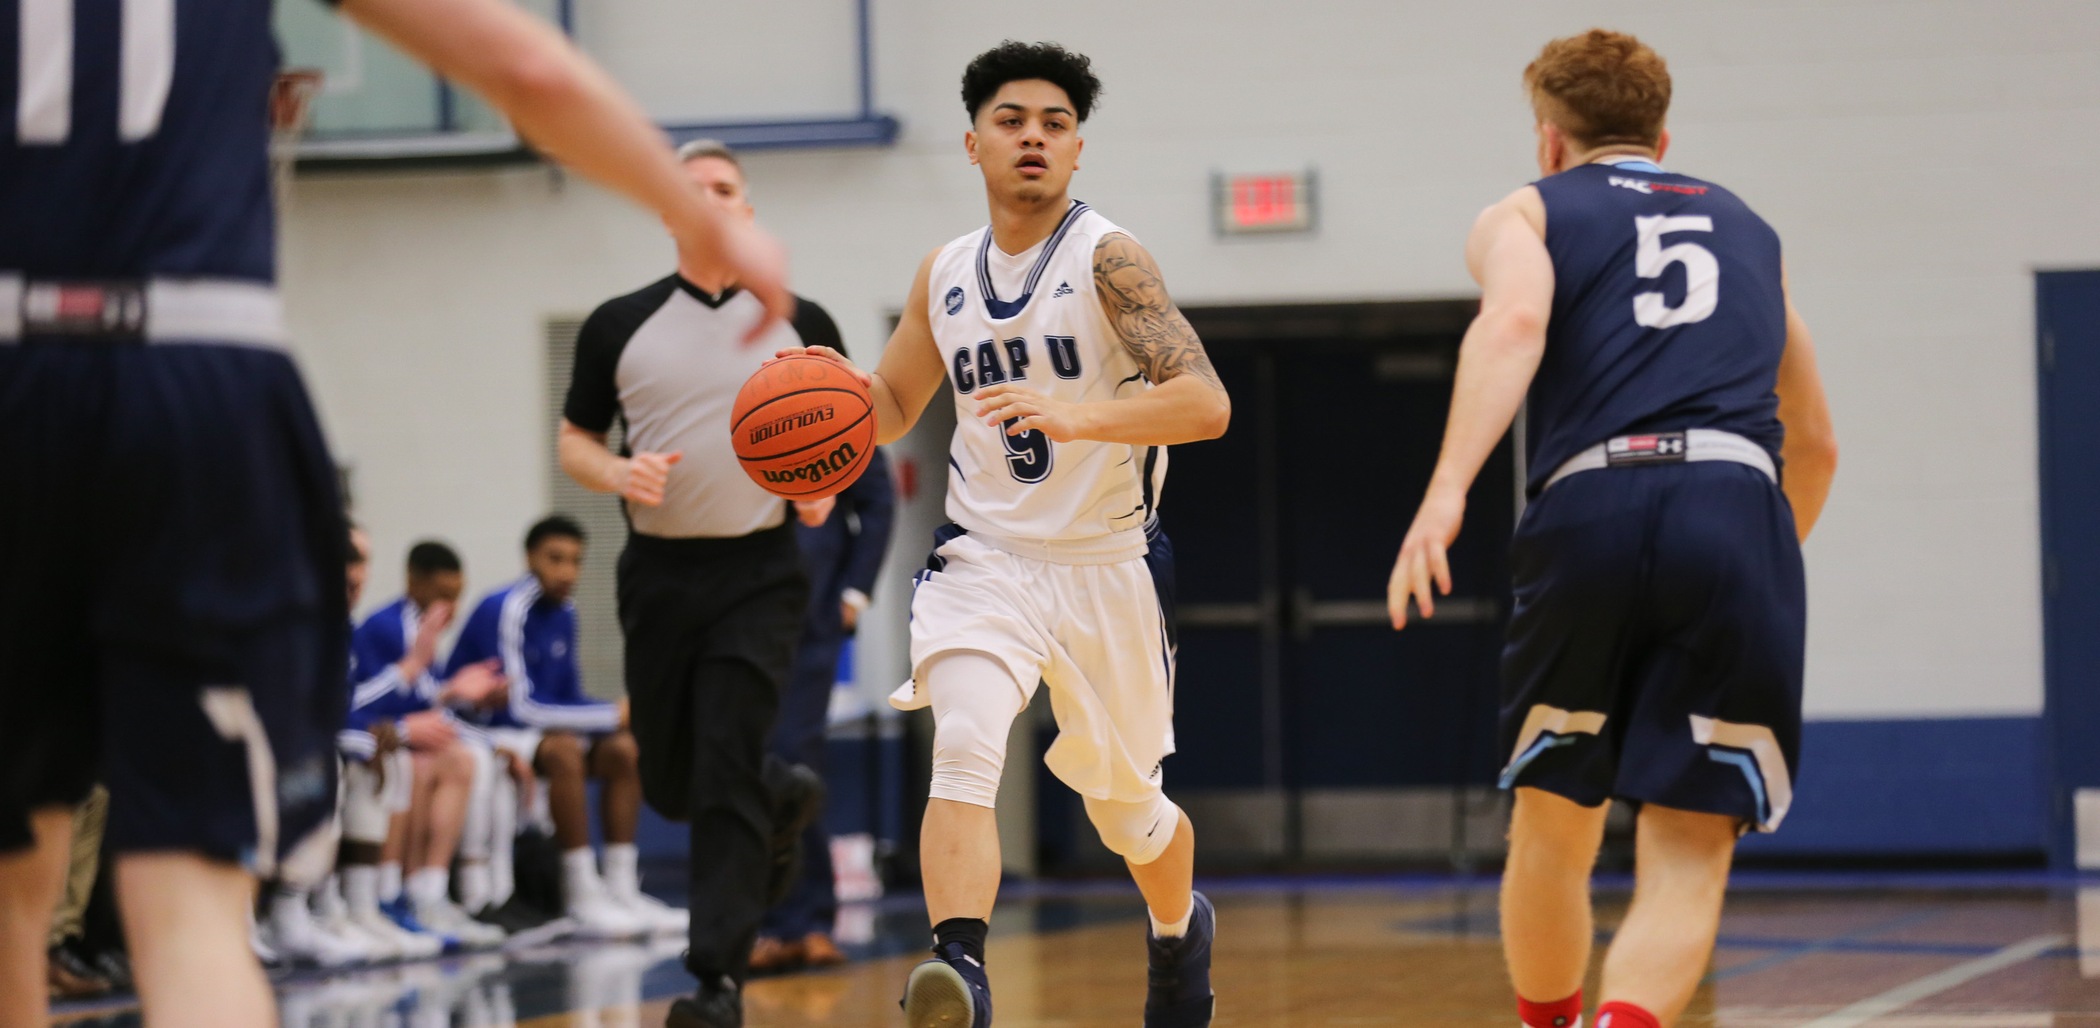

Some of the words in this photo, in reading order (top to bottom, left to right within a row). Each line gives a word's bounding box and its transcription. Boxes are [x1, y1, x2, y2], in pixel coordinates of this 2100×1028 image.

[1633, 213, 1720, 330] 5
[953, 336, 1030, 395] CAP
[1043, 334, 1082, 380] U
[749, 407, 835, 446] EVOLUTION
[761, 442, 859, 483] Wilson
